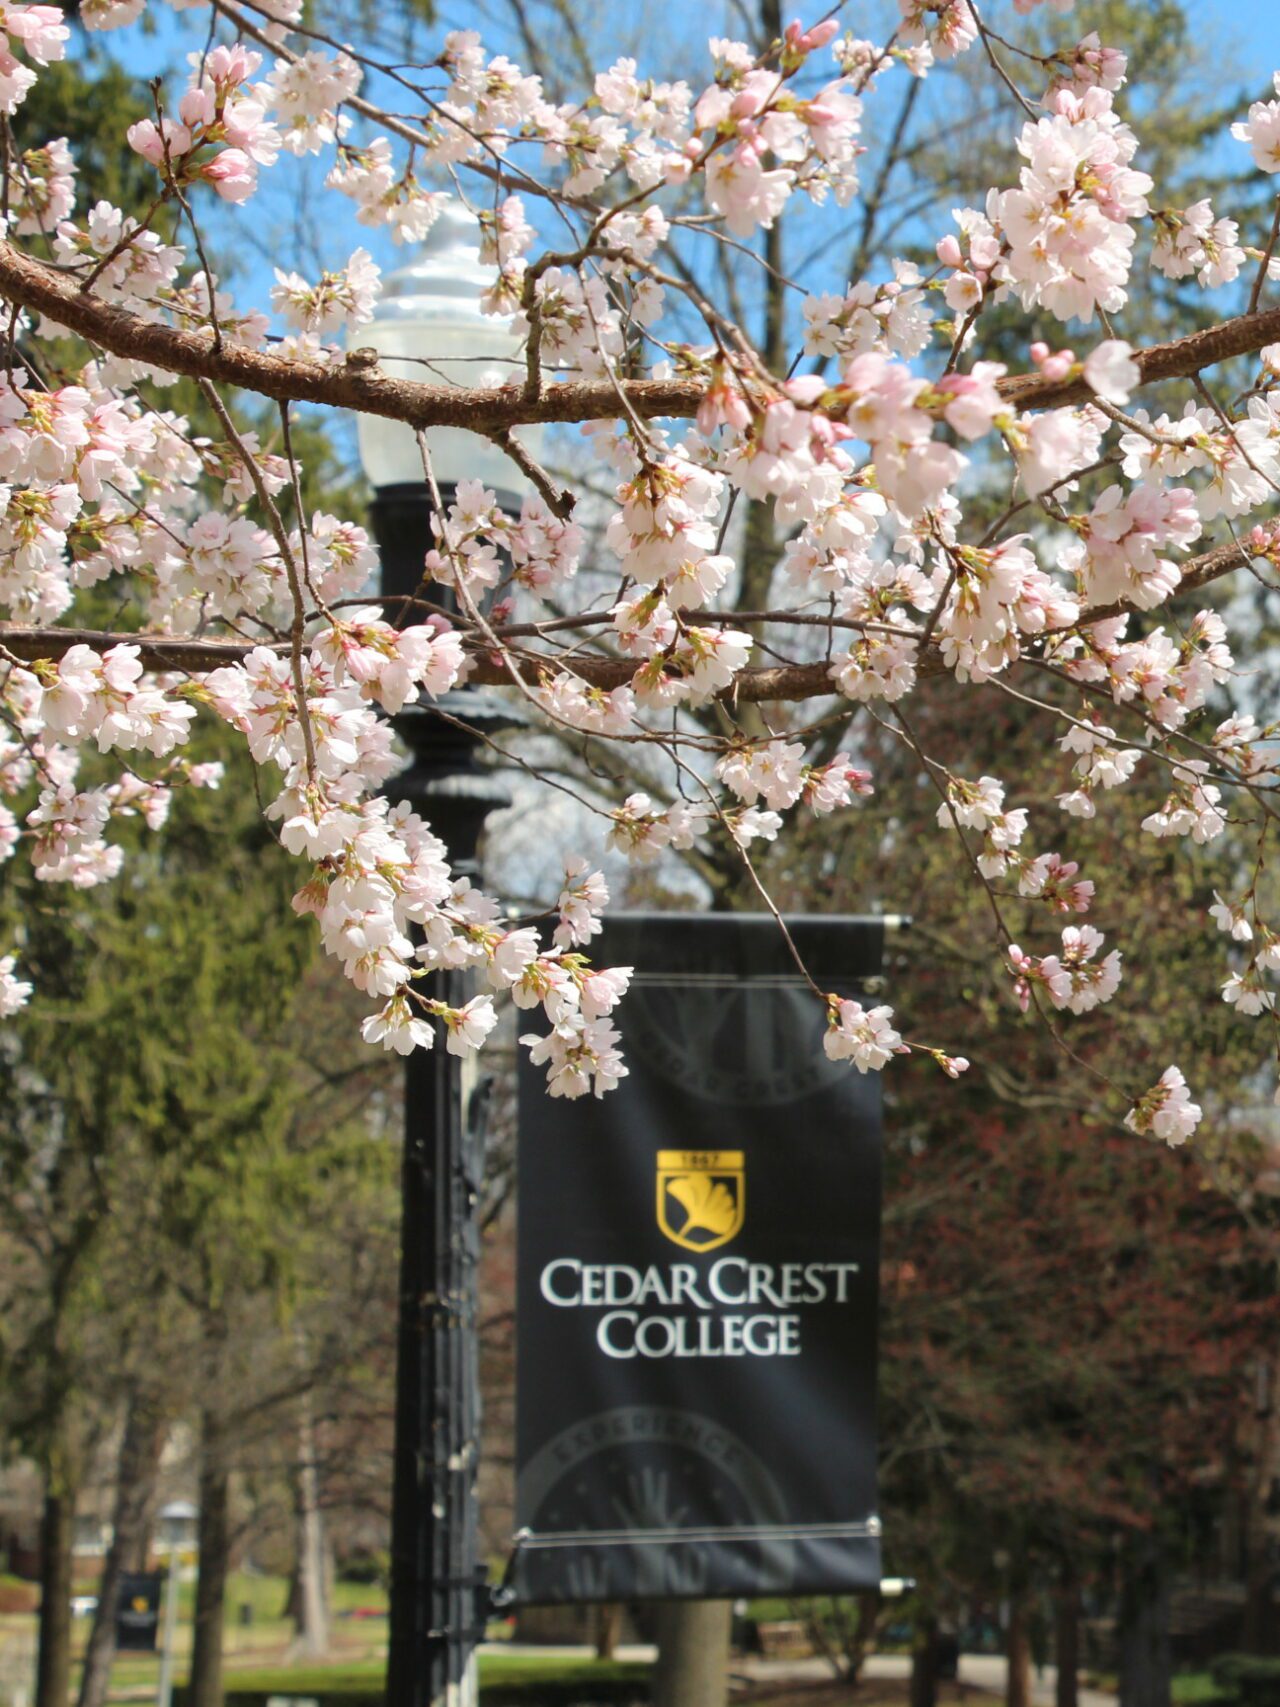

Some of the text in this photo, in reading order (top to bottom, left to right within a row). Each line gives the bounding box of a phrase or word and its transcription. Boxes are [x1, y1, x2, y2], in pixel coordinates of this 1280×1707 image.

[540, 1257, 859, 1309] CEDAR CREST
[597, 1311, 801, 1359] COLLEGE
